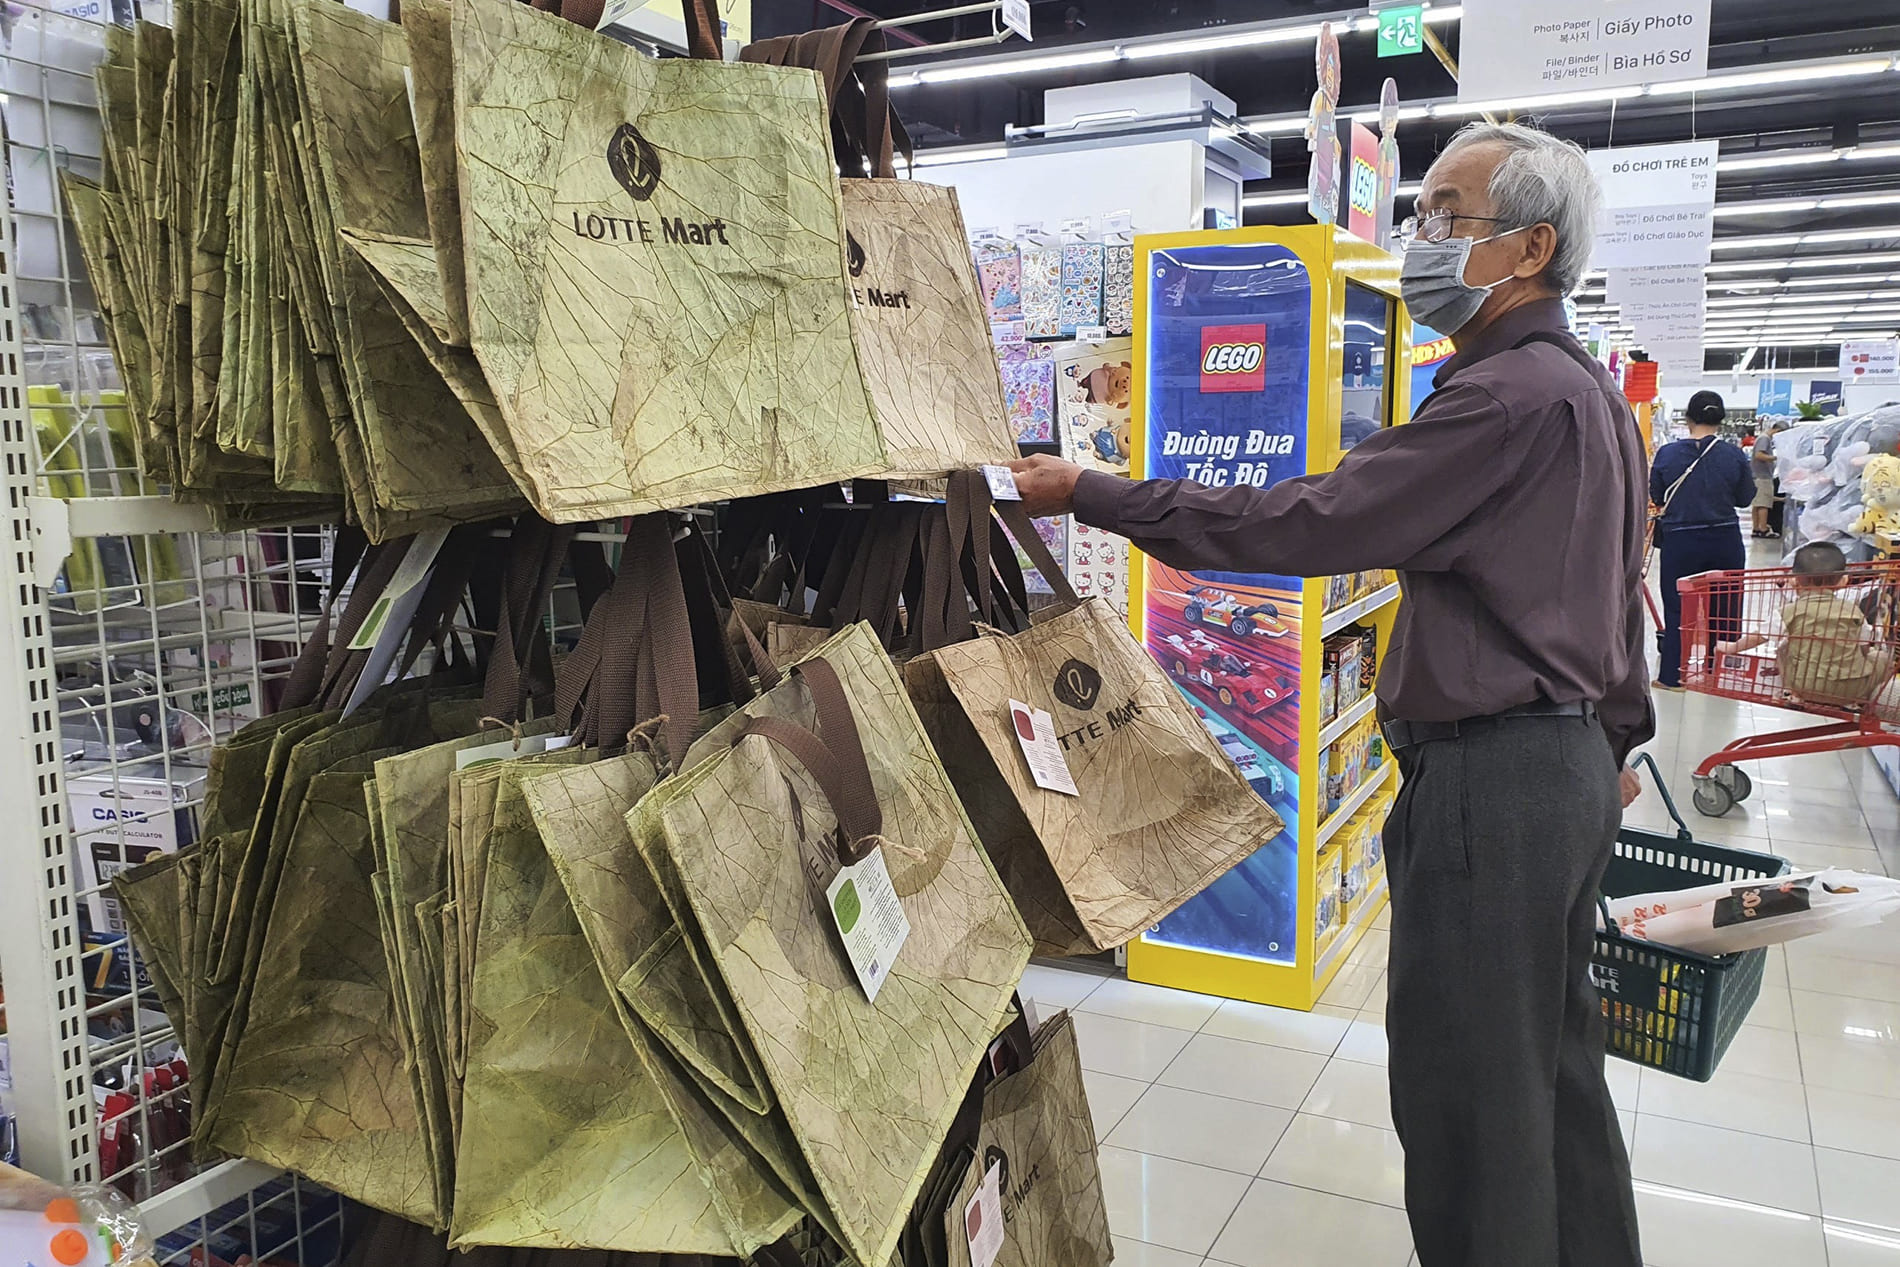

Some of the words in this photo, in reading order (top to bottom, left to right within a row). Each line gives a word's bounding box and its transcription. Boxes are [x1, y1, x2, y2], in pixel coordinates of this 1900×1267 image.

[1533, 22, 1562, 34] Photo
[1563, 20, 1592, 32] Paper
[1605, 18, 1641, 36] Giấy
[1644, 14, 1693, 31] Photo
[1560, 31, 1590, 44] 복사지
[1546, 57, 1567, 68] File/
[1569, 54, 1600, 66] Binder
[1613, 55, 1639, 70] Bìa
[1643, 50, 1665, 67] Hồ
[1669, 49, 1693, 64] Sơ
[1542, 65, 1599, 81] 파일/바인더
[1612, 160, 1630, 174] ĐỒ
[1632, 159, 1662, 172] CHƠI
[1665, 155, 1688, 169] TRẺ
[1690, 157, 1709, 168] EM
[1352, 159, 1376, 214] LEGO
[1691, 172, 1708, 182] Toys
[573, 212, 654, 243] LOTTE
[661, 216, 730, 246] Mart
[867, 287, 911, 310] Mart
[1202, 343, 1263, 374] LEGO
[1162, 429, 1240, 461] Đường
[1244, 429, 1296, 455] Đua
[1186, 457, 1228, 487] Tốc
[1105, 698, 1143, 731] Mart
[1013, 1163, 1041, 1210] Mart
